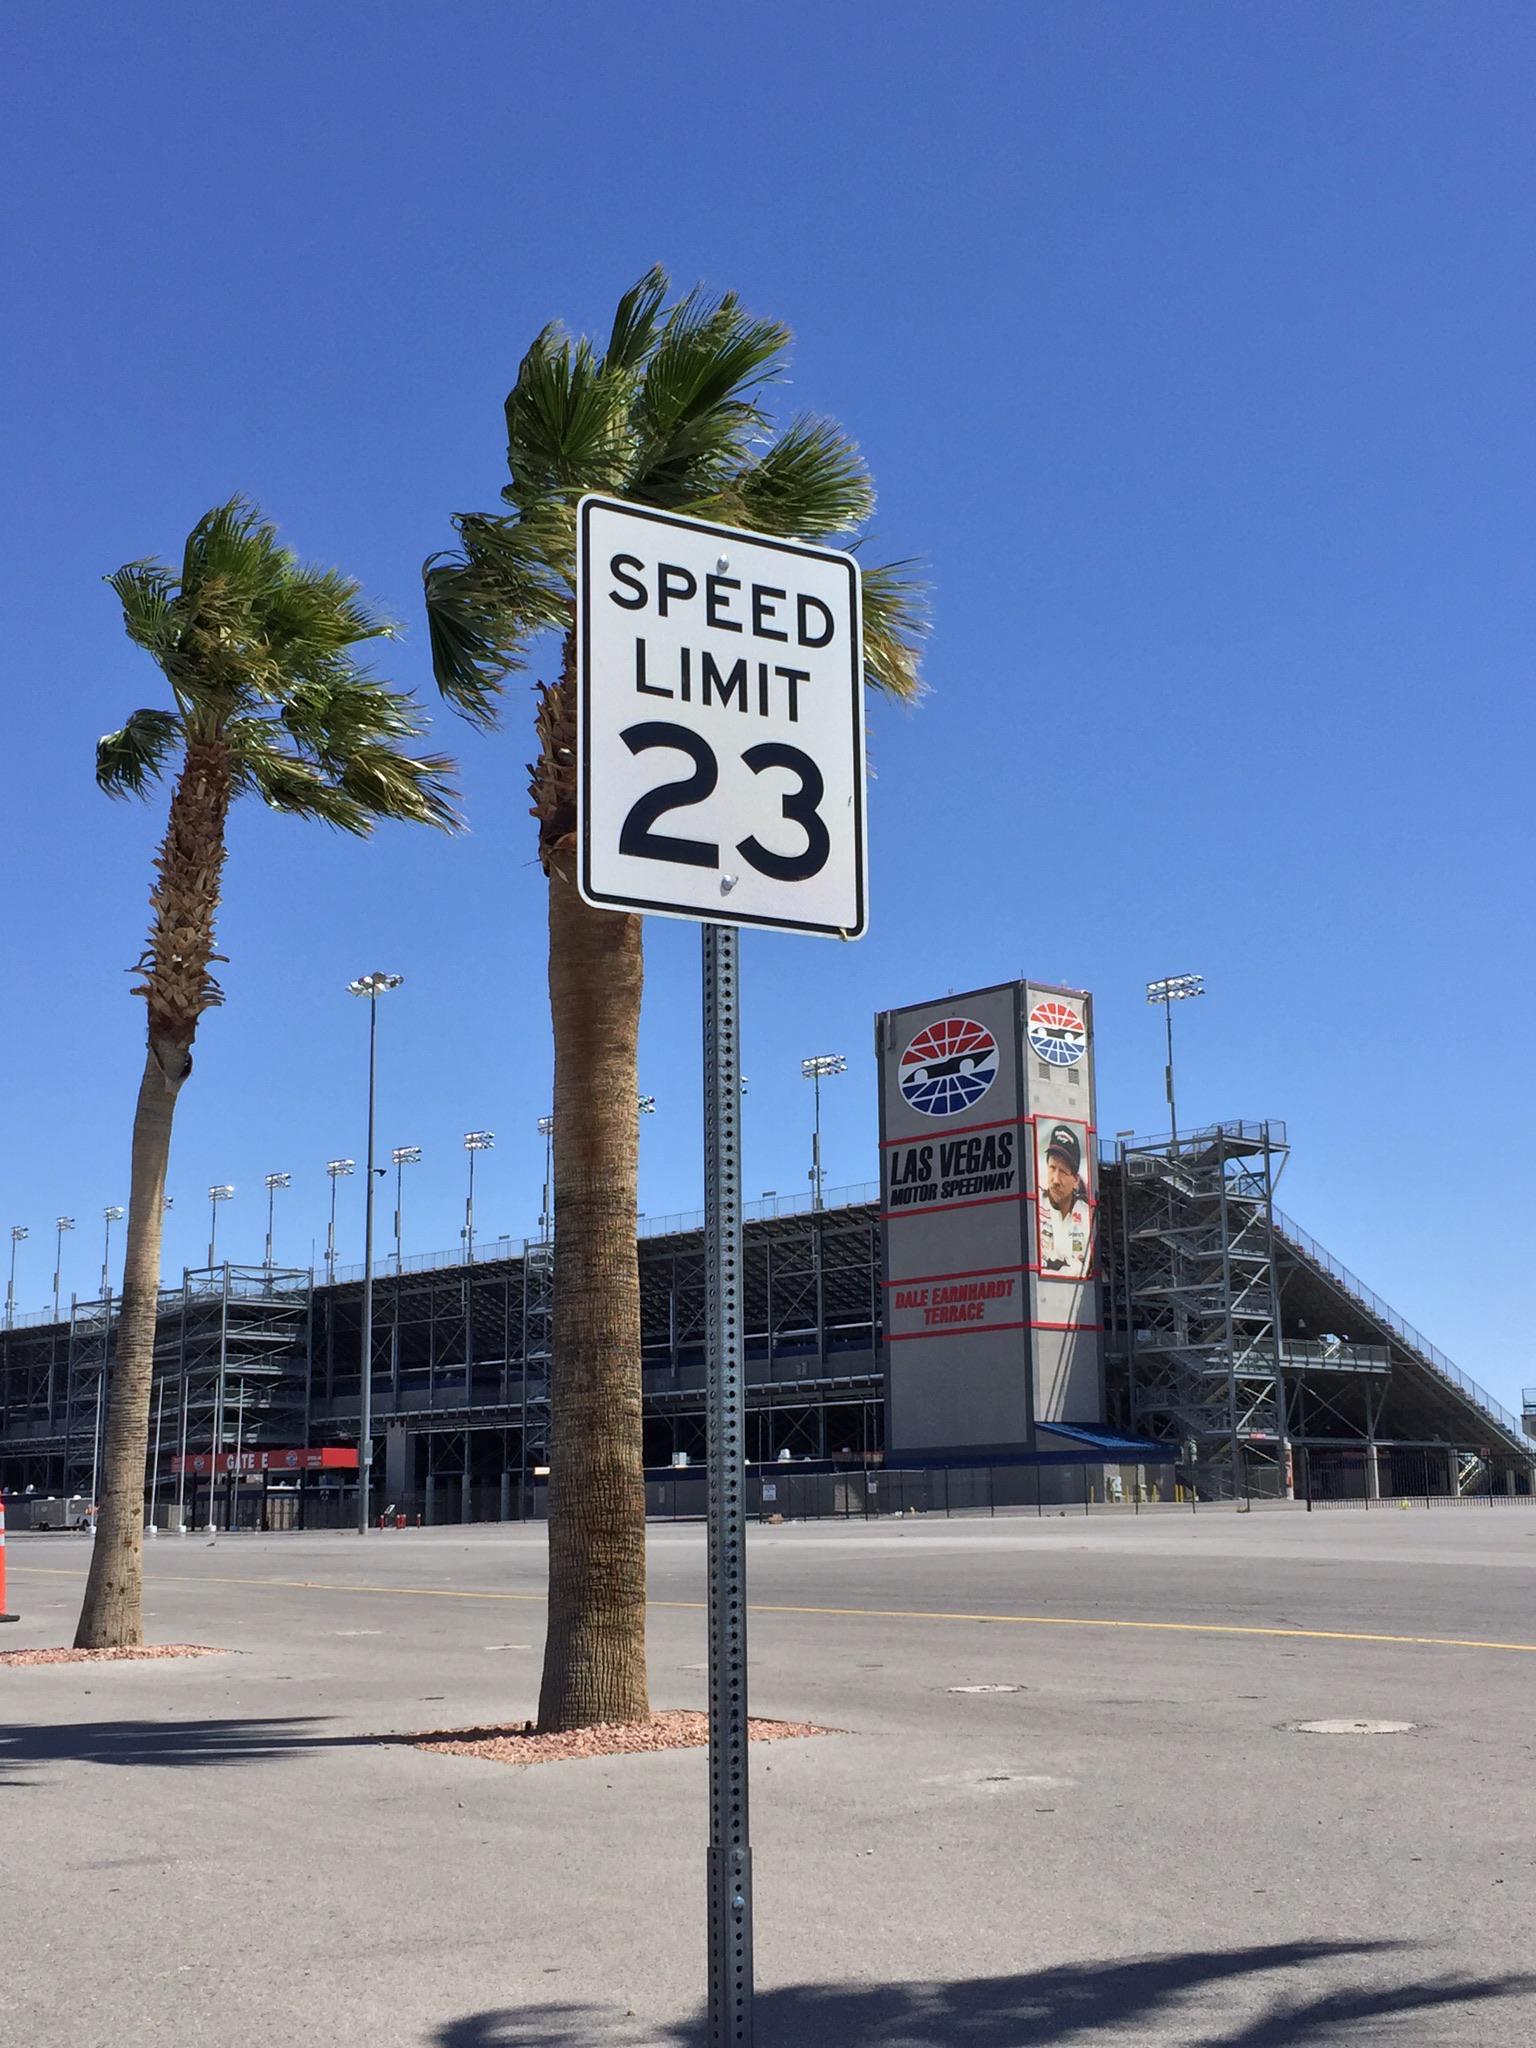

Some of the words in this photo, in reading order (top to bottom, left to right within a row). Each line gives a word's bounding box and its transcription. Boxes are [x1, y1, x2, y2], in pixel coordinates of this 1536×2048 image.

[609, 553, 835, 649] SPEED
[636, 638, 810, 722] LIMIT
[618, 721, 830, 882] 23
[890, 1146, 933, 1185] LAS
[940, 1132, 1013, 1178] VEGAS
[890, 1183, 937, 1206] MOTOR
[941, 1170, 1015, 1199] SPEEDWAY
[895, 1290, 928, 1309] DALE
[932, 1279, 1015, 1305] EARNHARDT
[924, 1302, 984, 1325] TERRACE
[227, 1453, 255, 1470] GATE
[261, 1452, 269, 1468] E
